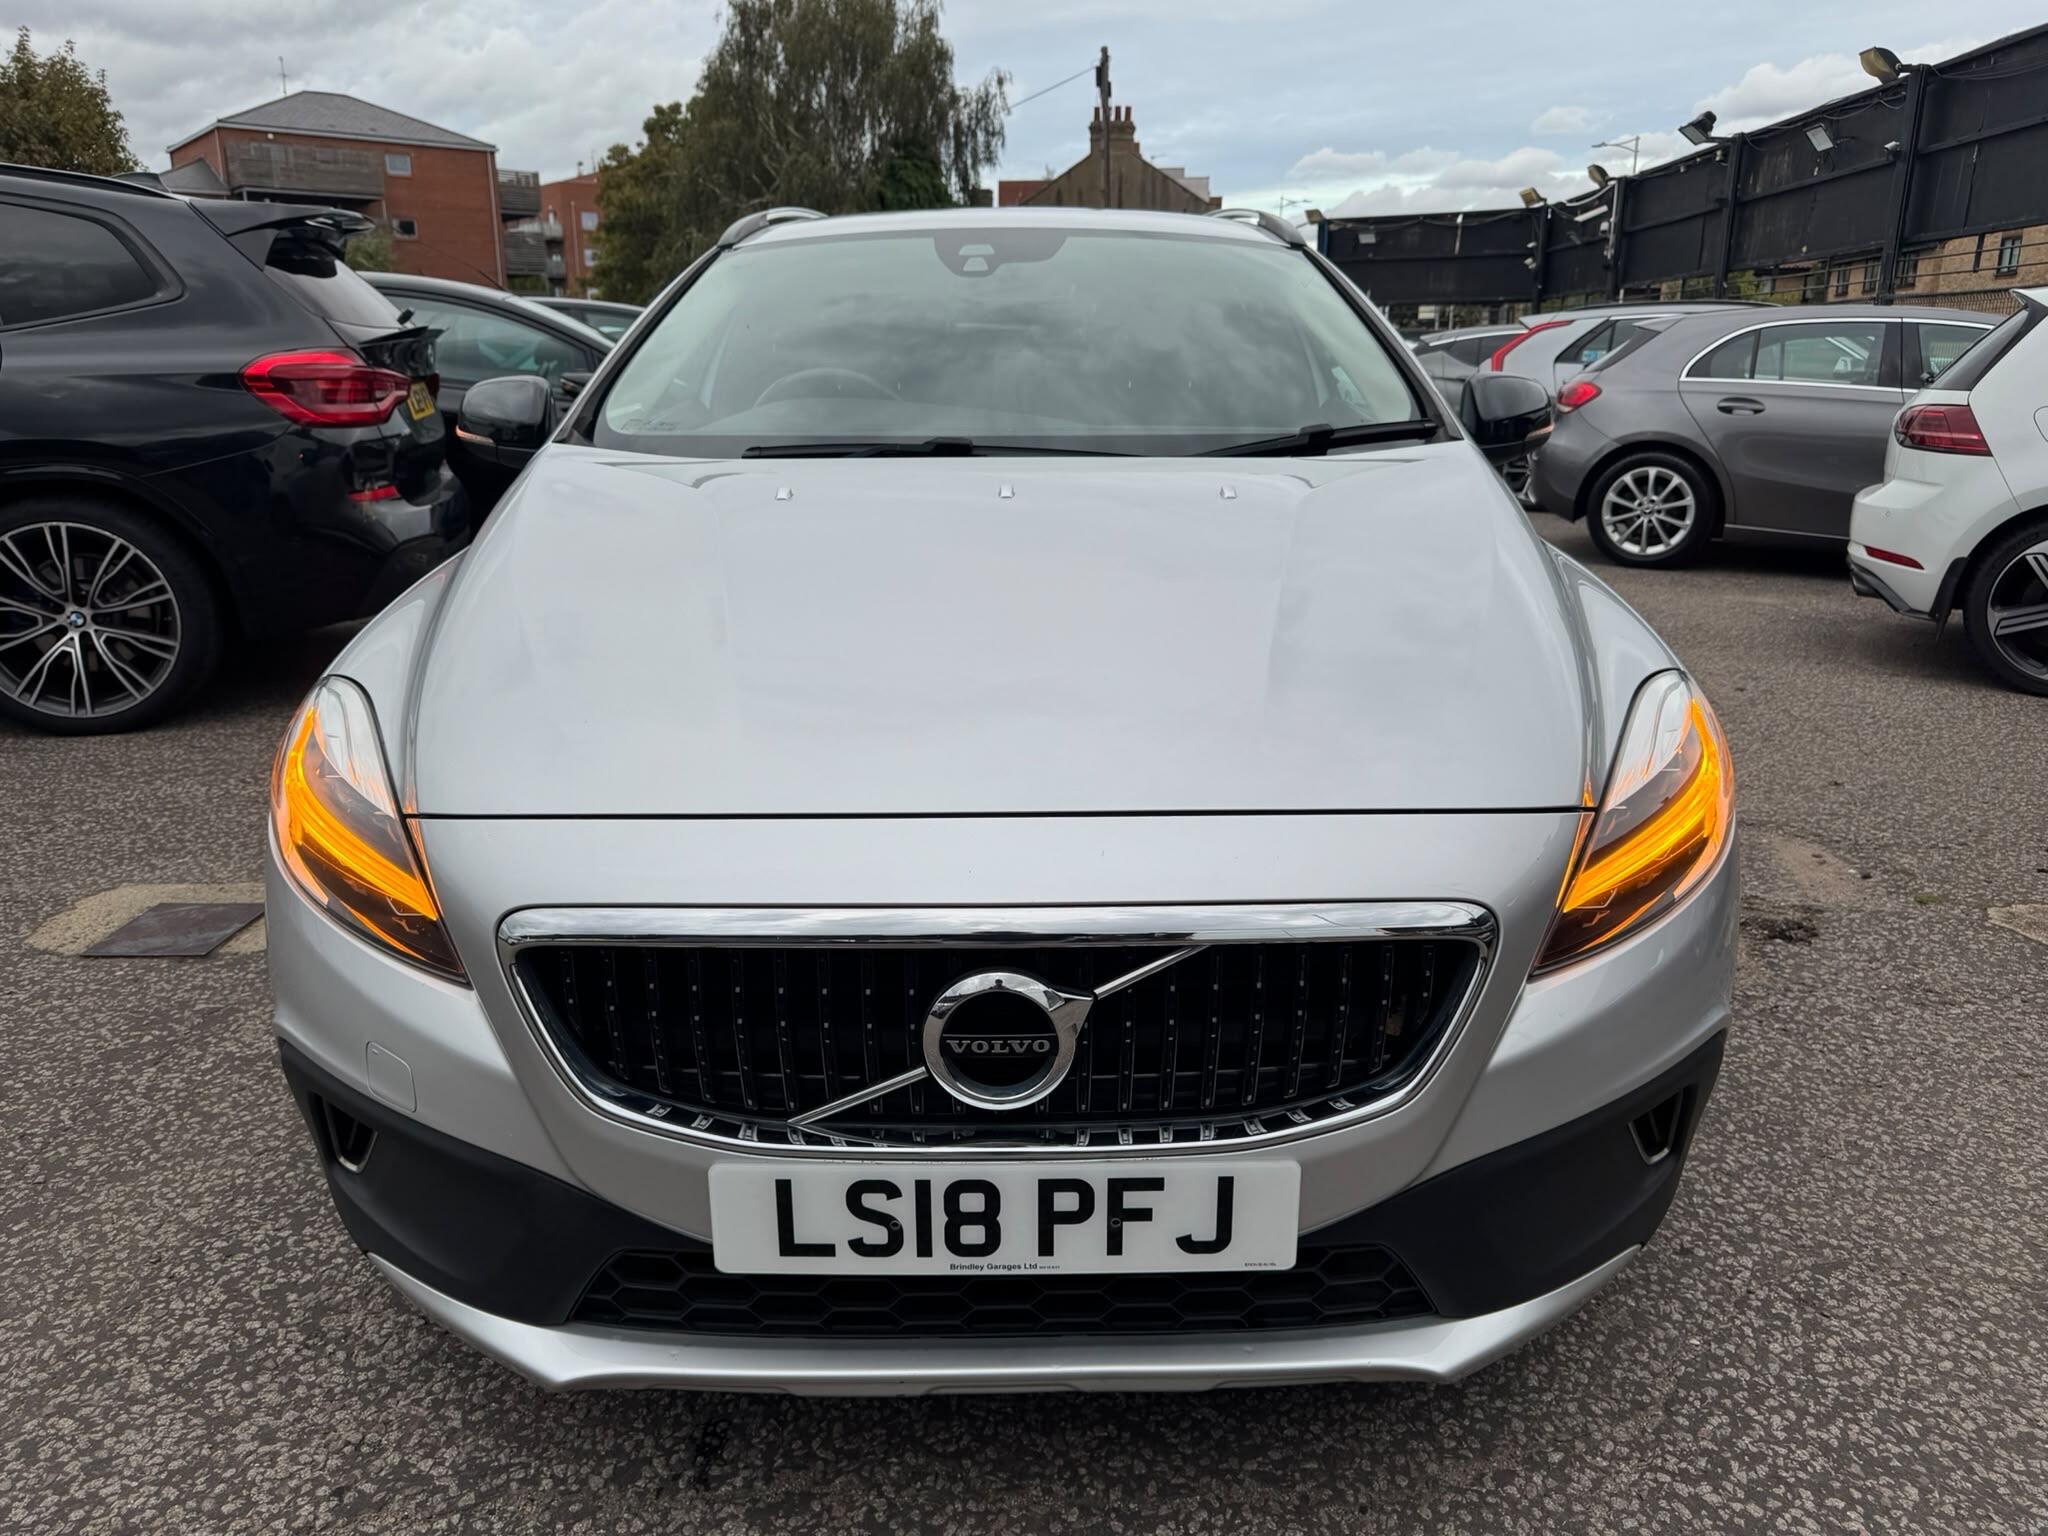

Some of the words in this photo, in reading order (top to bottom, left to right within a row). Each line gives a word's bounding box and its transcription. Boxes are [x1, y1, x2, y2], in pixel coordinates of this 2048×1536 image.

[946, 1039, 1051, 1054] VOLVO
[775, 1178, 1002, 1258] LS18
[1037, 1175, 1235, 1257] PFJ
[949, 1263, 985, 1272] Brindley
[986, 1262, 1022, 1272] Garages
[1023, 1262, 1038, 1271] Ltd
